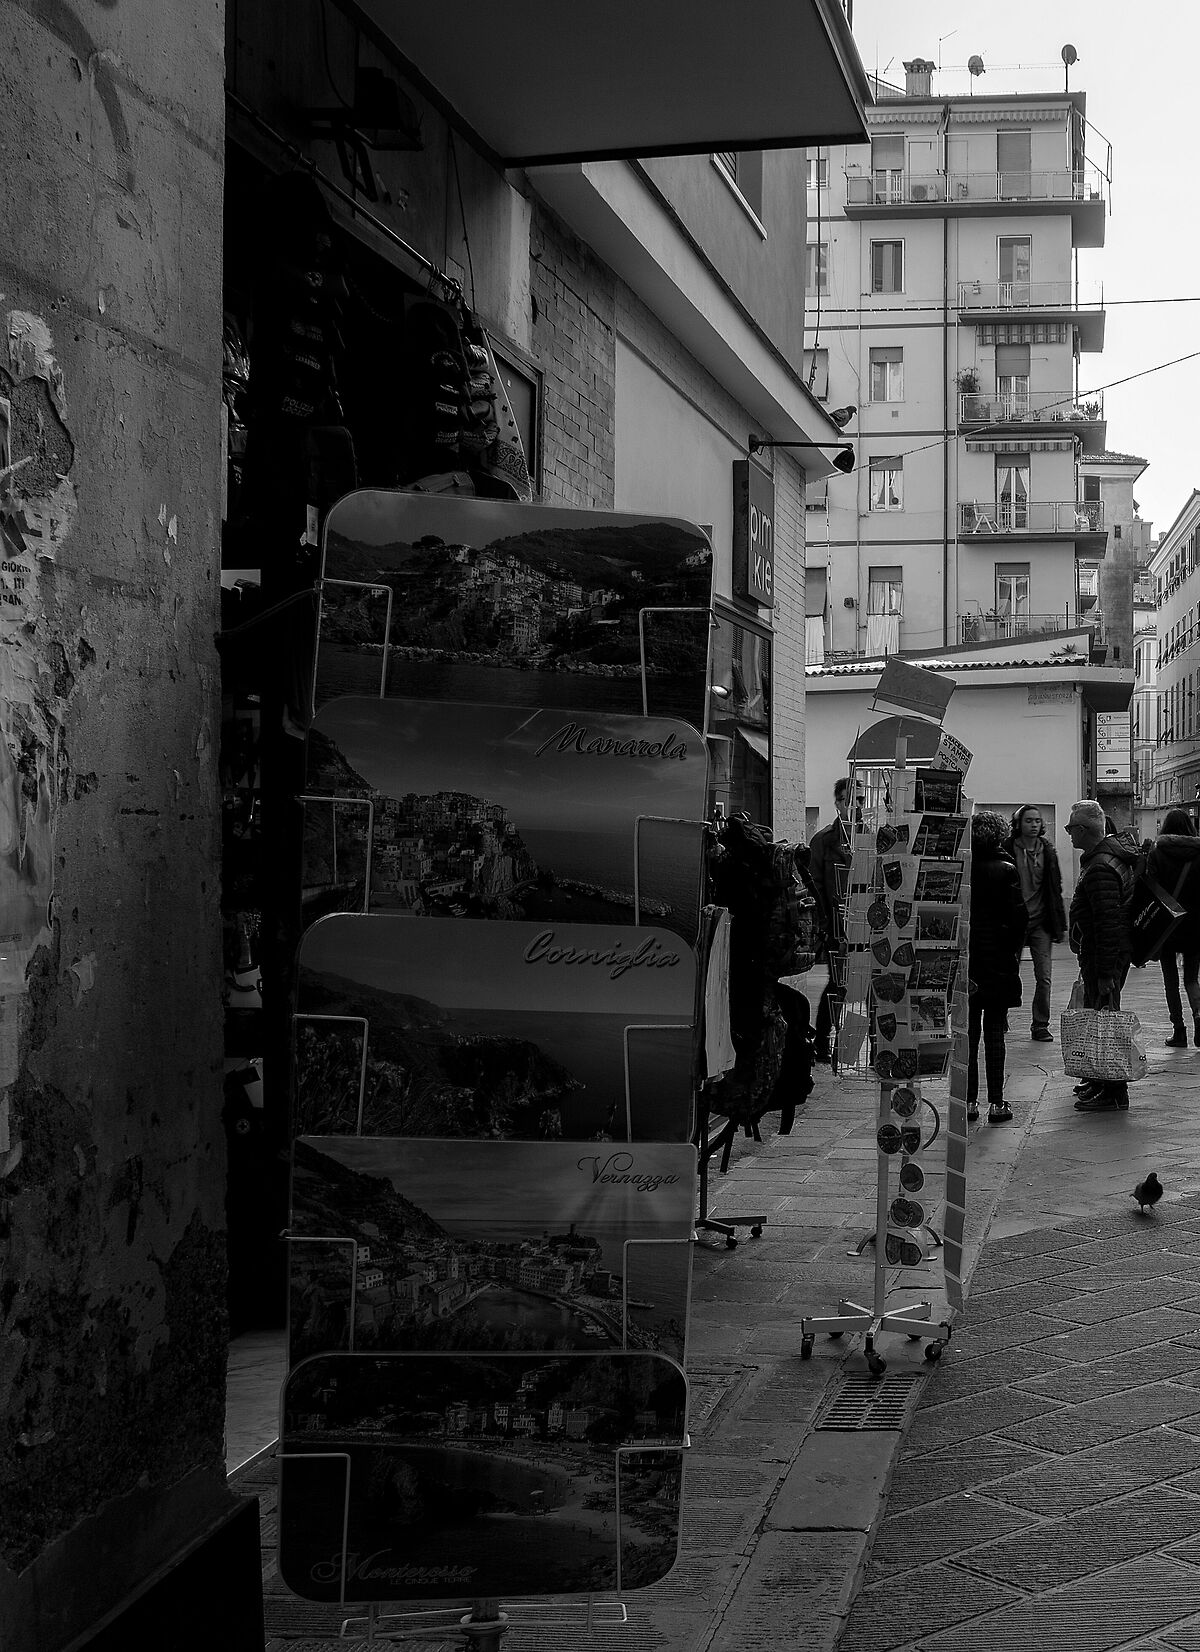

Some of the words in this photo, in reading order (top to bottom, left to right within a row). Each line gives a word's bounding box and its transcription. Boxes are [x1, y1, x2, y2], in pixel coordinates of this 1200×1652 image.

[535, 722, 687, 761] Manarola
[942, 738, 970, 766] STAMPS
[524, 929, 681, 980] Corniglia
[576, 1151, 681, 1192] Vernazza
[310, 1547, 480, 1584] Monterosso
